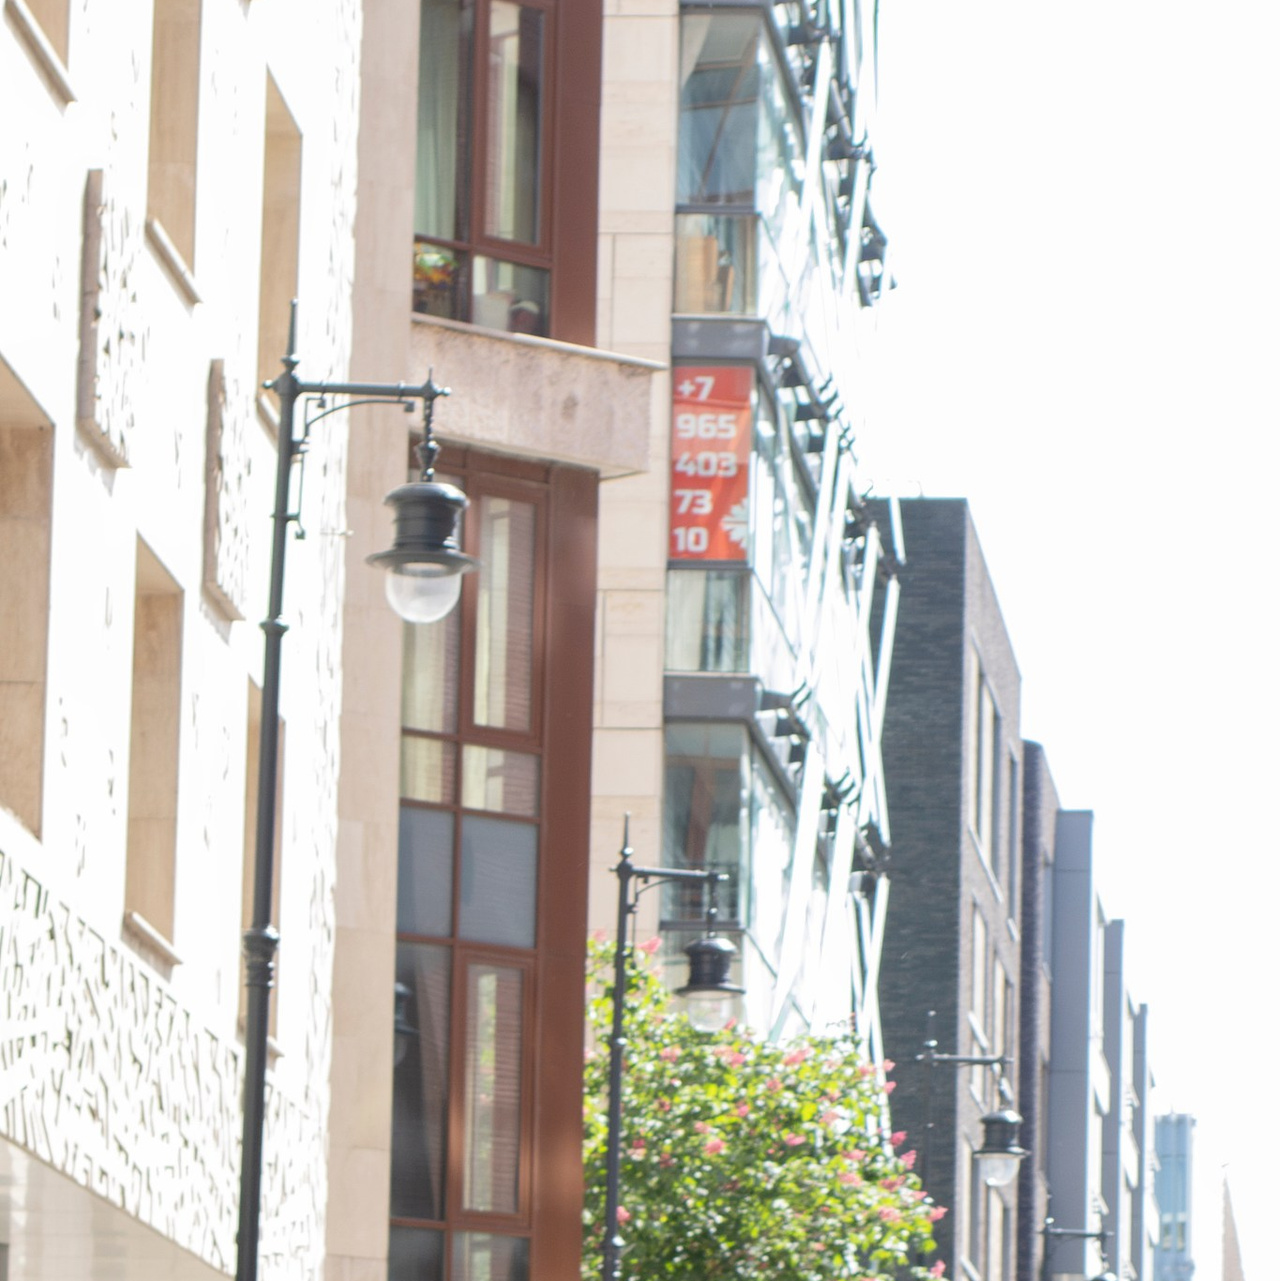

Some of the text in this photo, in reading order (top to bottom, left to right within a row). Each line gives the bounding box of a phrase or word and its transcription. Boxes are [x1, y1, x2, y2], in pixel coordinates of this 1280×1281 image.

[678, 376, 714, 401] +7
[676, 413, 737, 439] 965
[675, 451, 737, 477] 403
[674, 489, 713, 515] 73
[673, 526, 709, 552] 10
